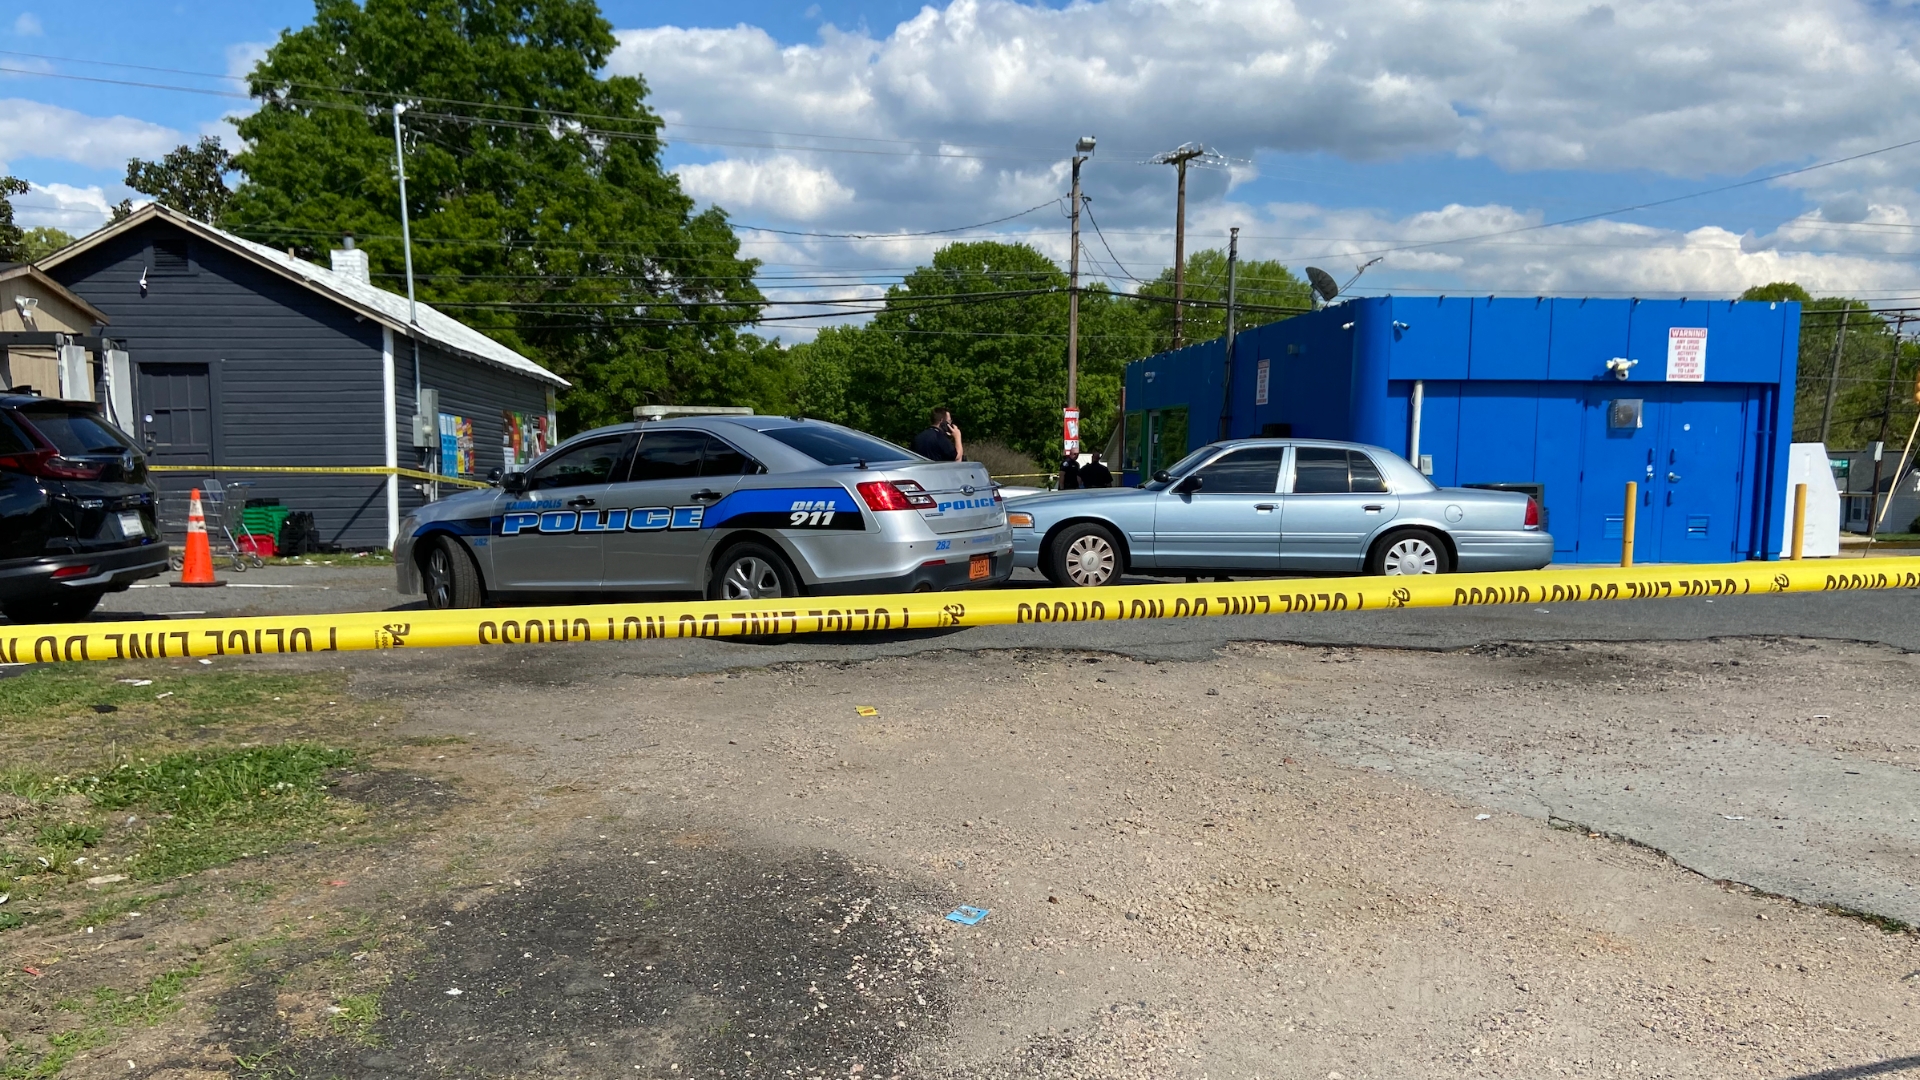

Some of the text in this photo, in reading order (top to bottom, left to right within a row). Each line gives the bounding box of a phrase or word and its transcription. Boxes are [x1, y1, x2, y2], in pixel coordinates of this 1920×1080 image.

[1671, 329, 1705, 338] WARNING
[505, 499, 563, 510] KANNAPOLIS
[790, 500, 836, 511] DIAL
[938, 497, 995, 512] POLICE
[501, 505, 705, 535] POLICE
[790, 510, 836, 526] 911
[935, 540, 951, 550] 282
